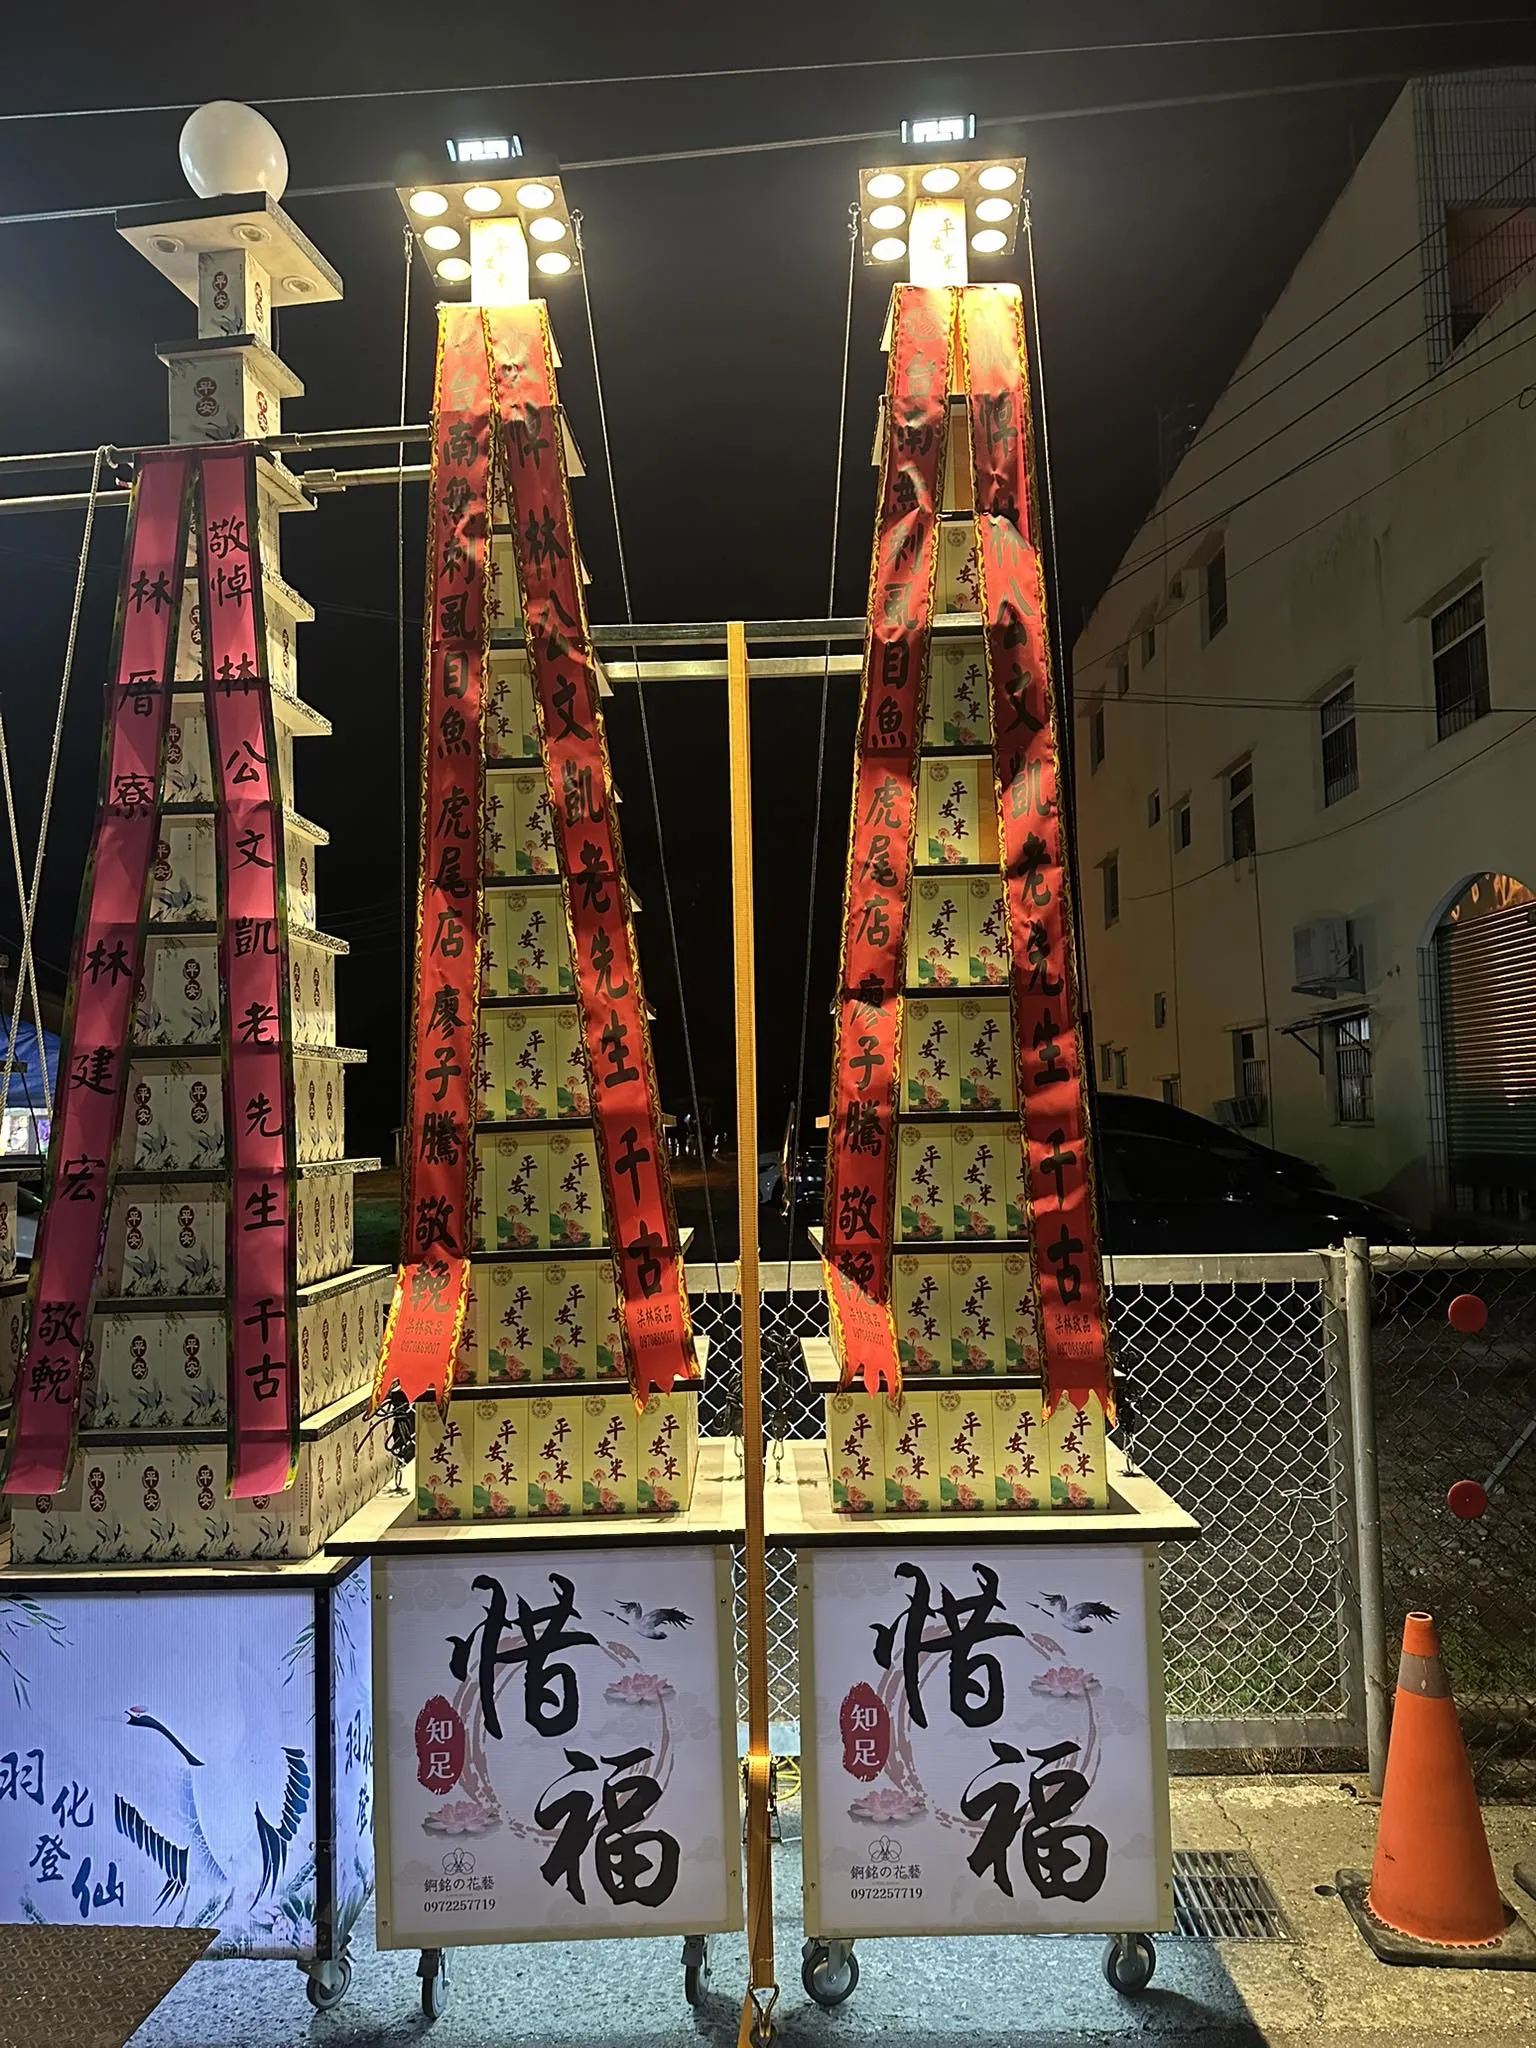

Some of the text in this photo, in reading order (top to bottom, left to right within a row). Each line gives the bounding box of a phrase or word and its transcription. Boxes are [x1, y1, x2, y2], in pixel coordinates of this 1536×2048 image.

[425, 1716, 455, 1780] 知足
[850, 1704, 880, 1768] 知足
[424, 1898, 496, 1913] 0972257719
[850, 1887, 923, 1901] 0972257719
